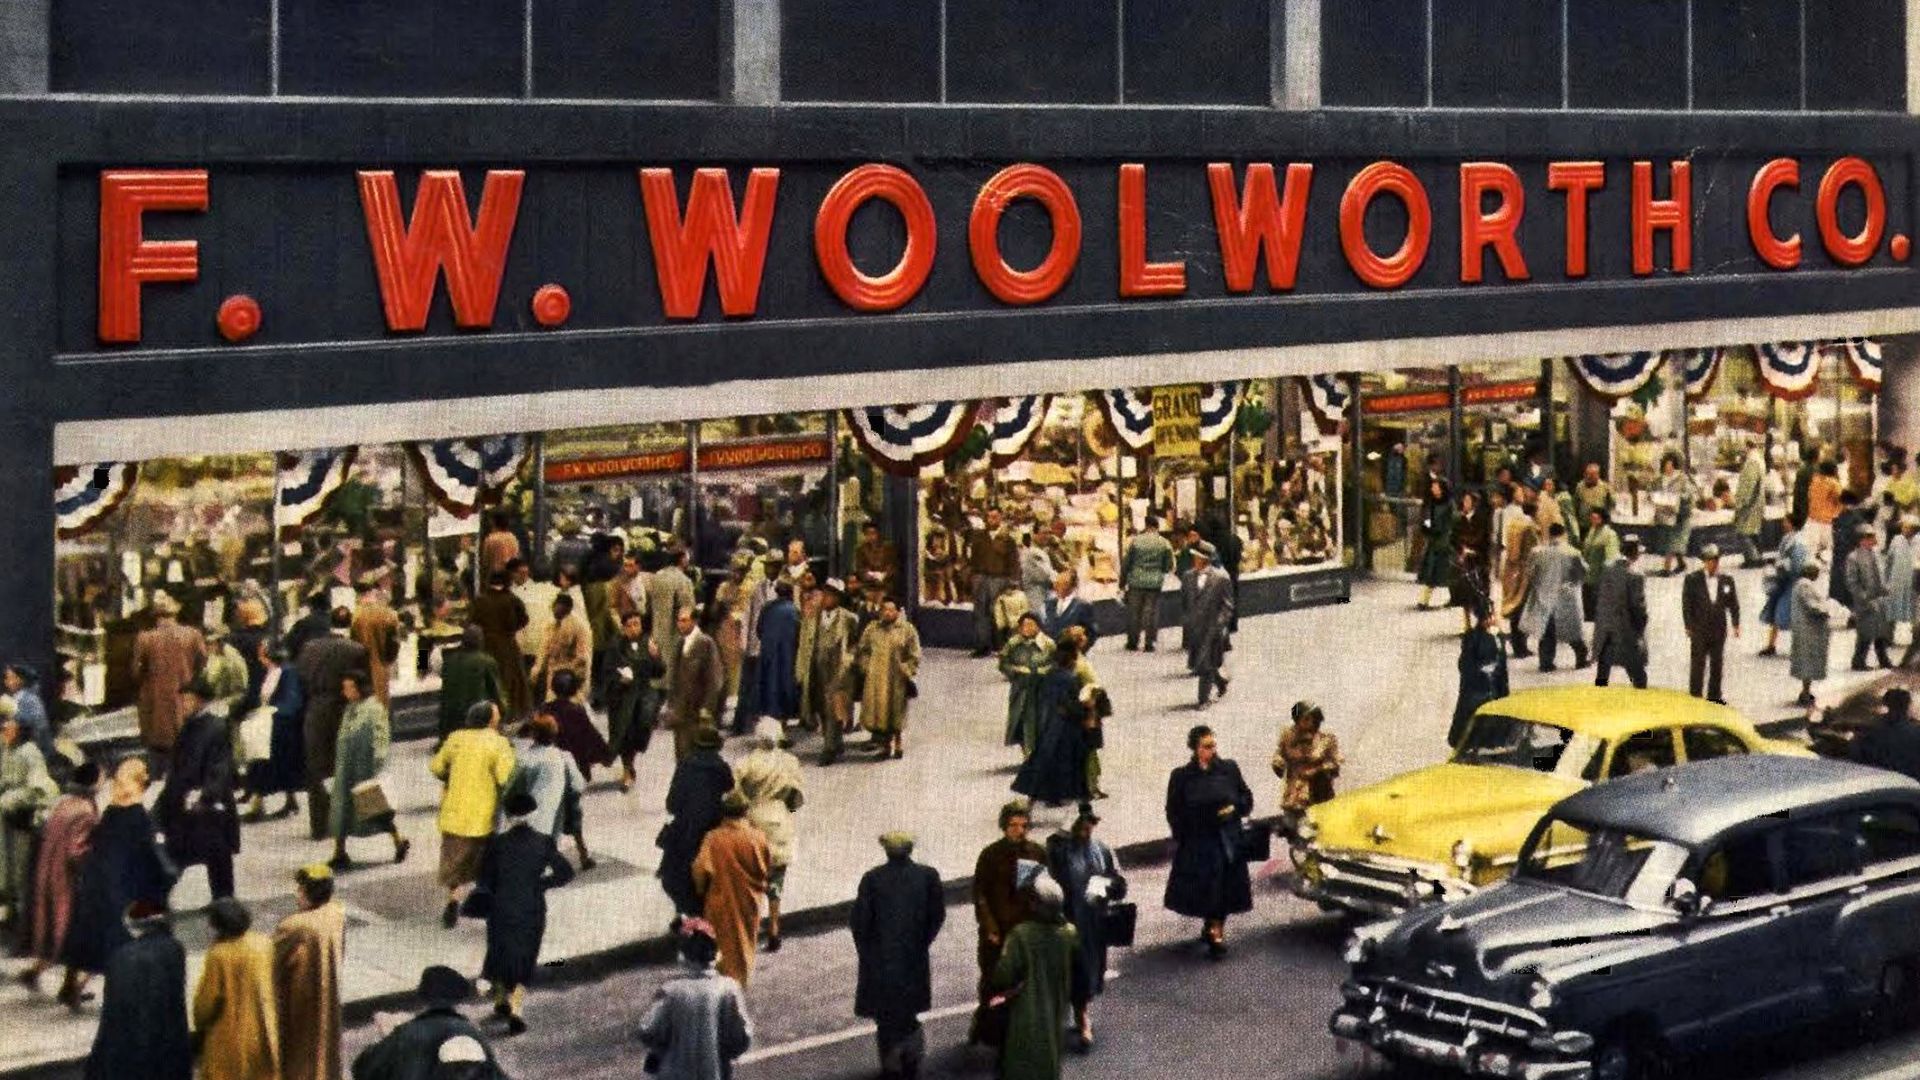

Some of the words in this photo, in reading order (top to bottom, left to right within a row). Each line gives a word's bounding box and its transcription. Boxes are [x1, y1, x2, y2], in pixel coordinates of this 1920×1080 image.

[98, 169, 262, 344] F.
[356, 168, 571, 333] W.
[640, 158, 1693, 321] WOOLWORTH
[1746, 156, 1911, 270] CO.
[1153, 392, 1201, 420] GRAND
